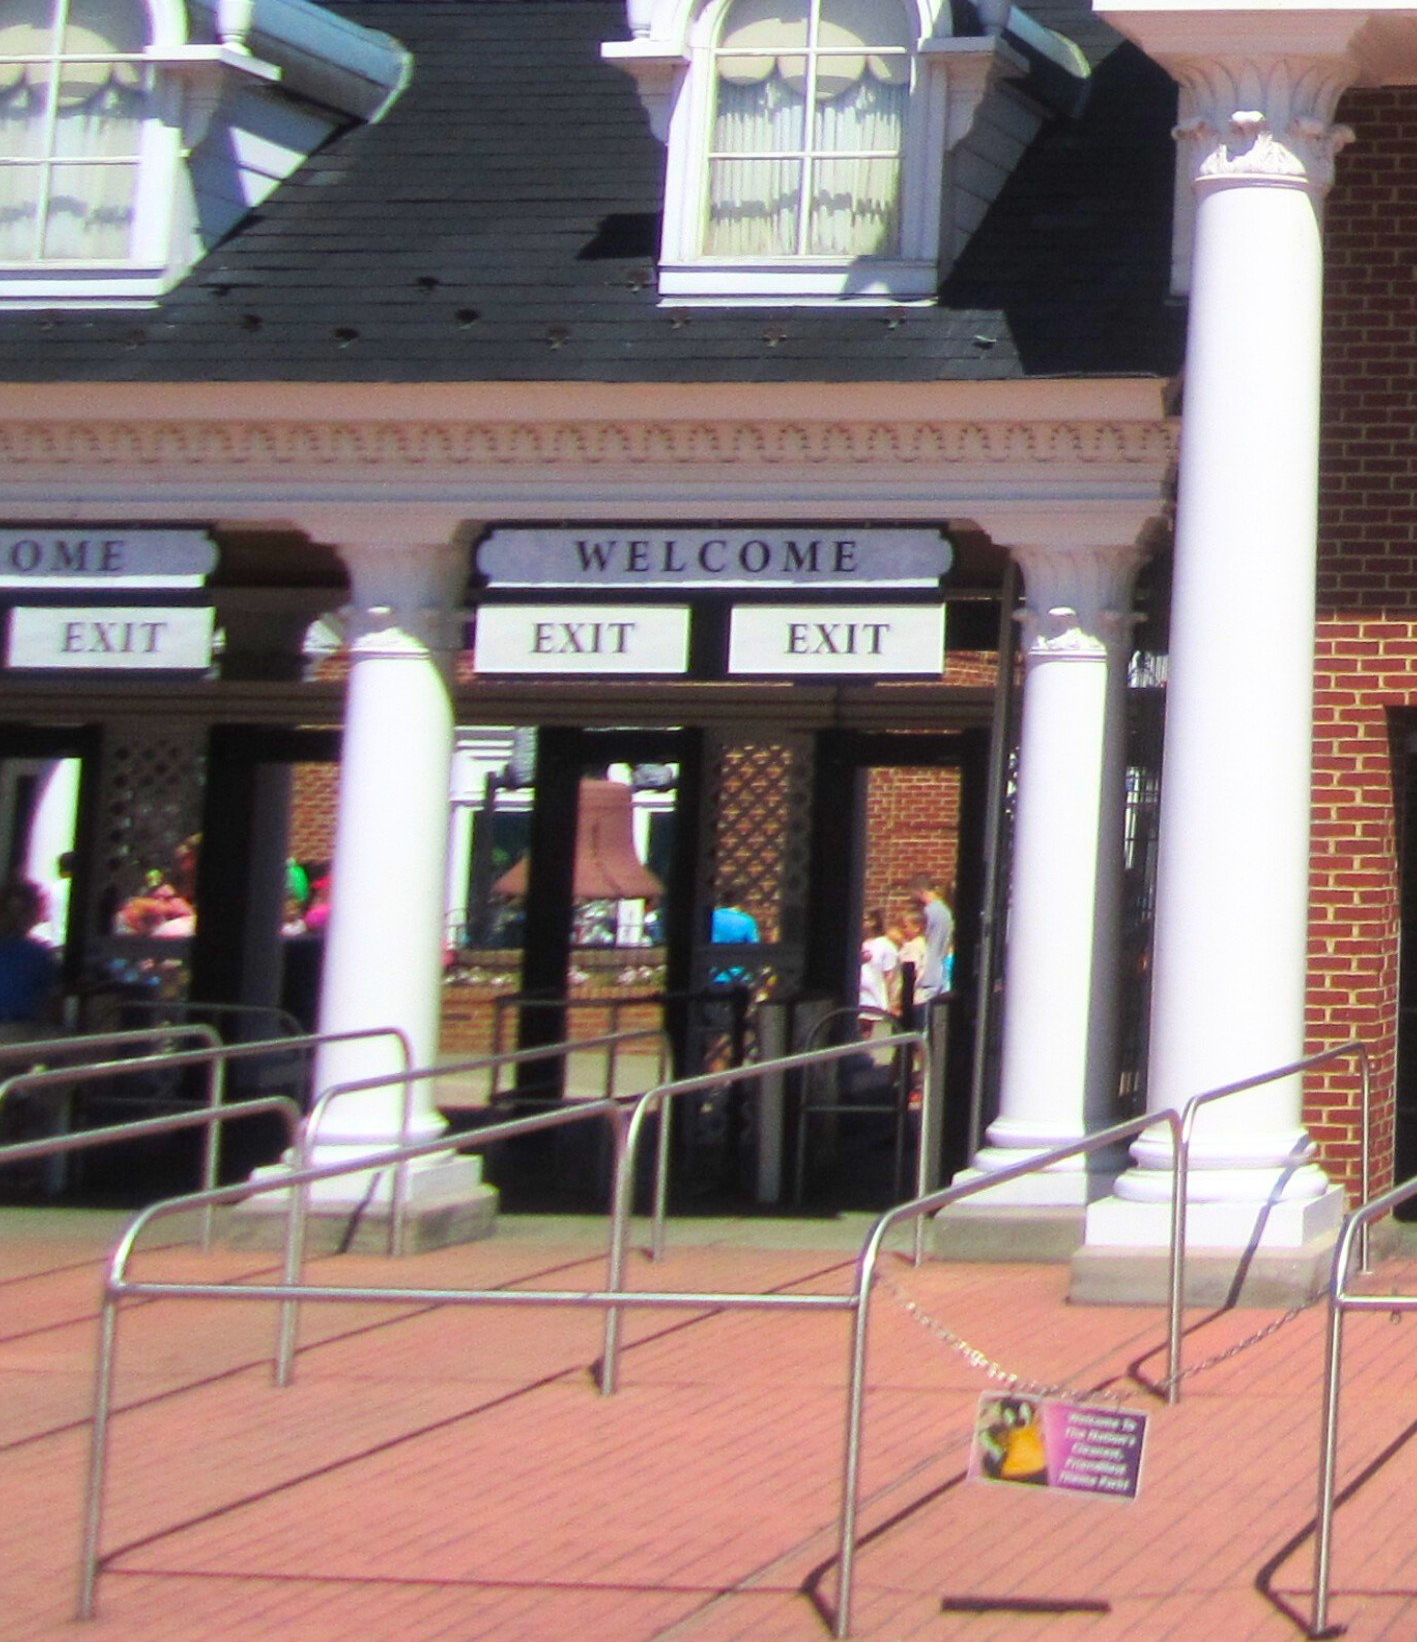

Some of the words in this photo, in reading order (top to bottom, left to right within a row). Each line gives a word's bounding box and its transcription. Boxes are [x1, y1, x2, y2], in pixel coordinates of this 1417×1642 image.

[573, 539, 858, 573] WELCOME
[60, 622, 168, 653] EXIT
[532, 622, 636, 654] EXIT
[784, 622, 891, 655] EXIT
